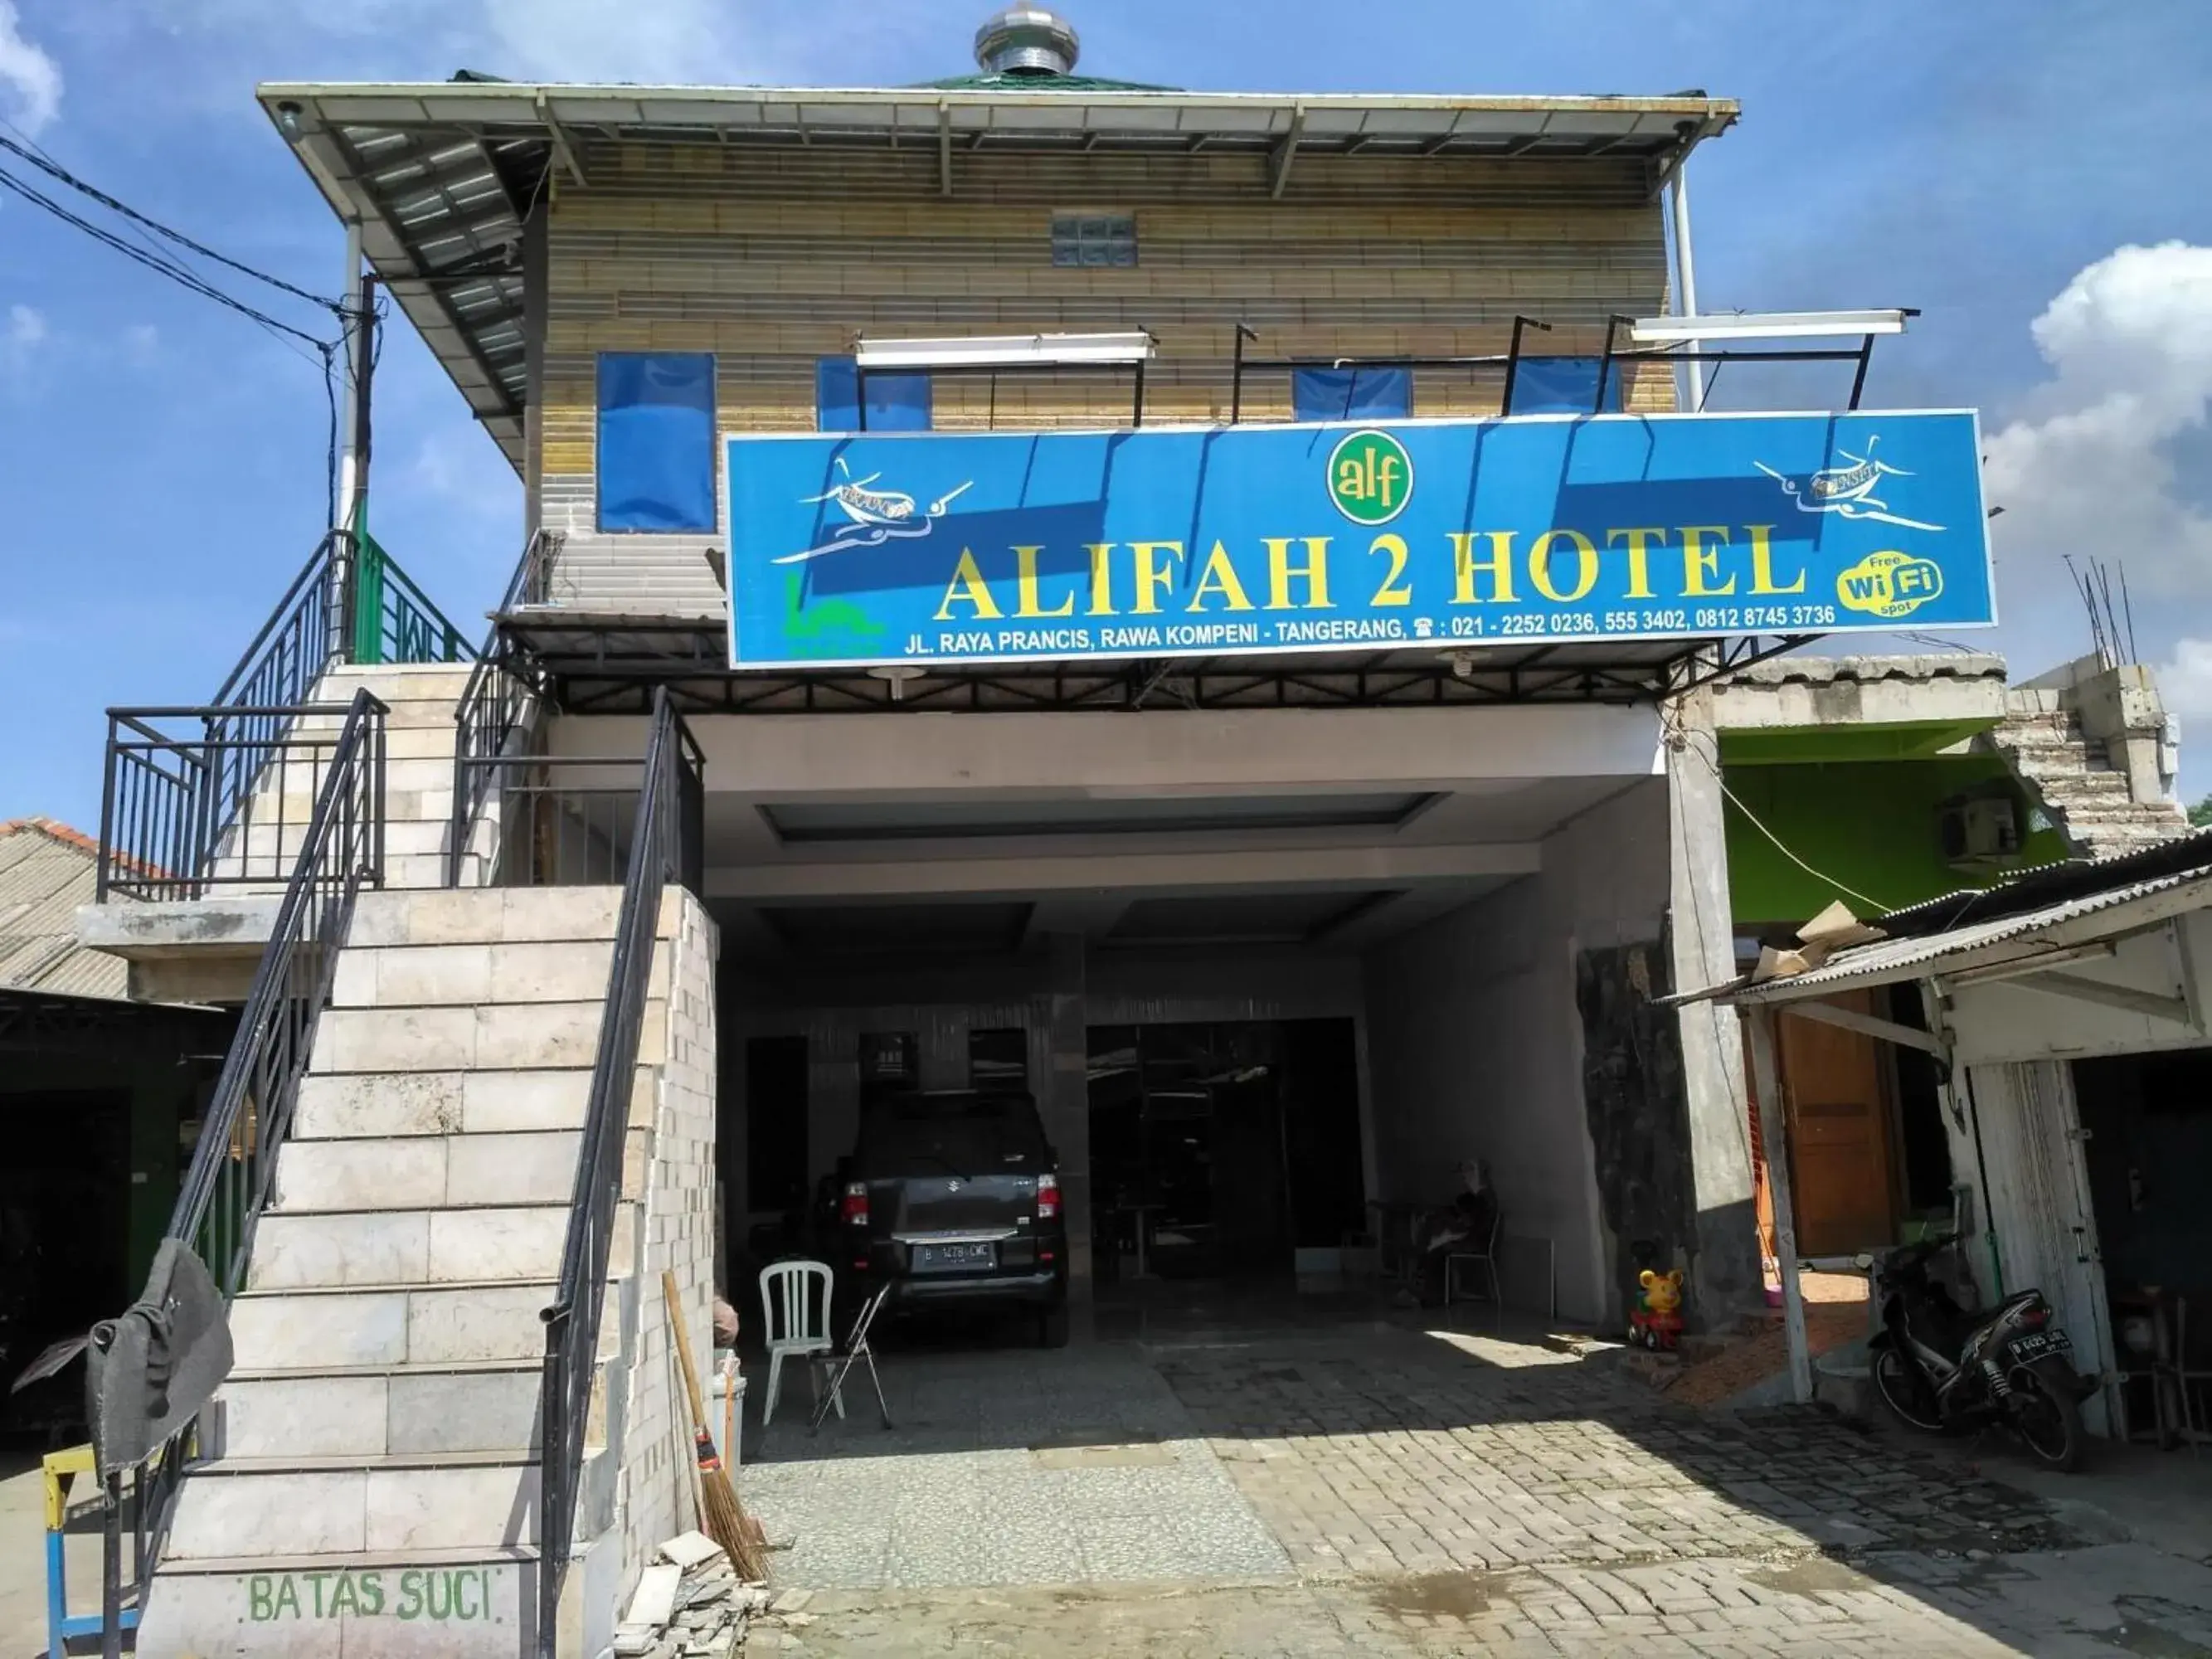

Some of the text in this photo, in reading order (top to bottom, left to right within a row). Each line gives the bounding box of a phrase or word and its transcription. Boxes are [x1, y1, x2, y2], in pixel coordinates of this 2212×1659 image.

[1338, 447, 1401, 508] alf
[932, 523, 1806, 620] ALIFAH 2 HOTEL
[1869, 557, 1902, 568] Free
[905, 634, 934, 654] JL.
[940, 632, 994, 653] RAYA
[999, 630, 1095, 651] PRANCIS,
[1101, 627, 1161, 648] RAWA
[1166, 624, 1258, 645] KOMPENI
[1275, 619, 1407, 642] TANGERANG,
[1451, 615, 1483, 636] 021
[1502, 614, 1546, 635] 2252
[1550, 612, 1600, 635] 0236,
[1605, 611, 1637, 631] 555
[1642, 610, 1690, 632] 3402,
[1695, 608, 1738, 629] 0812
[1744, 606, 1787, 626] 8745
[1793, 605, 1835, 624] 3736
[1880, 601, 1912, 615] spot
[250, 1569, 490, 1621] BATAS SUCI
